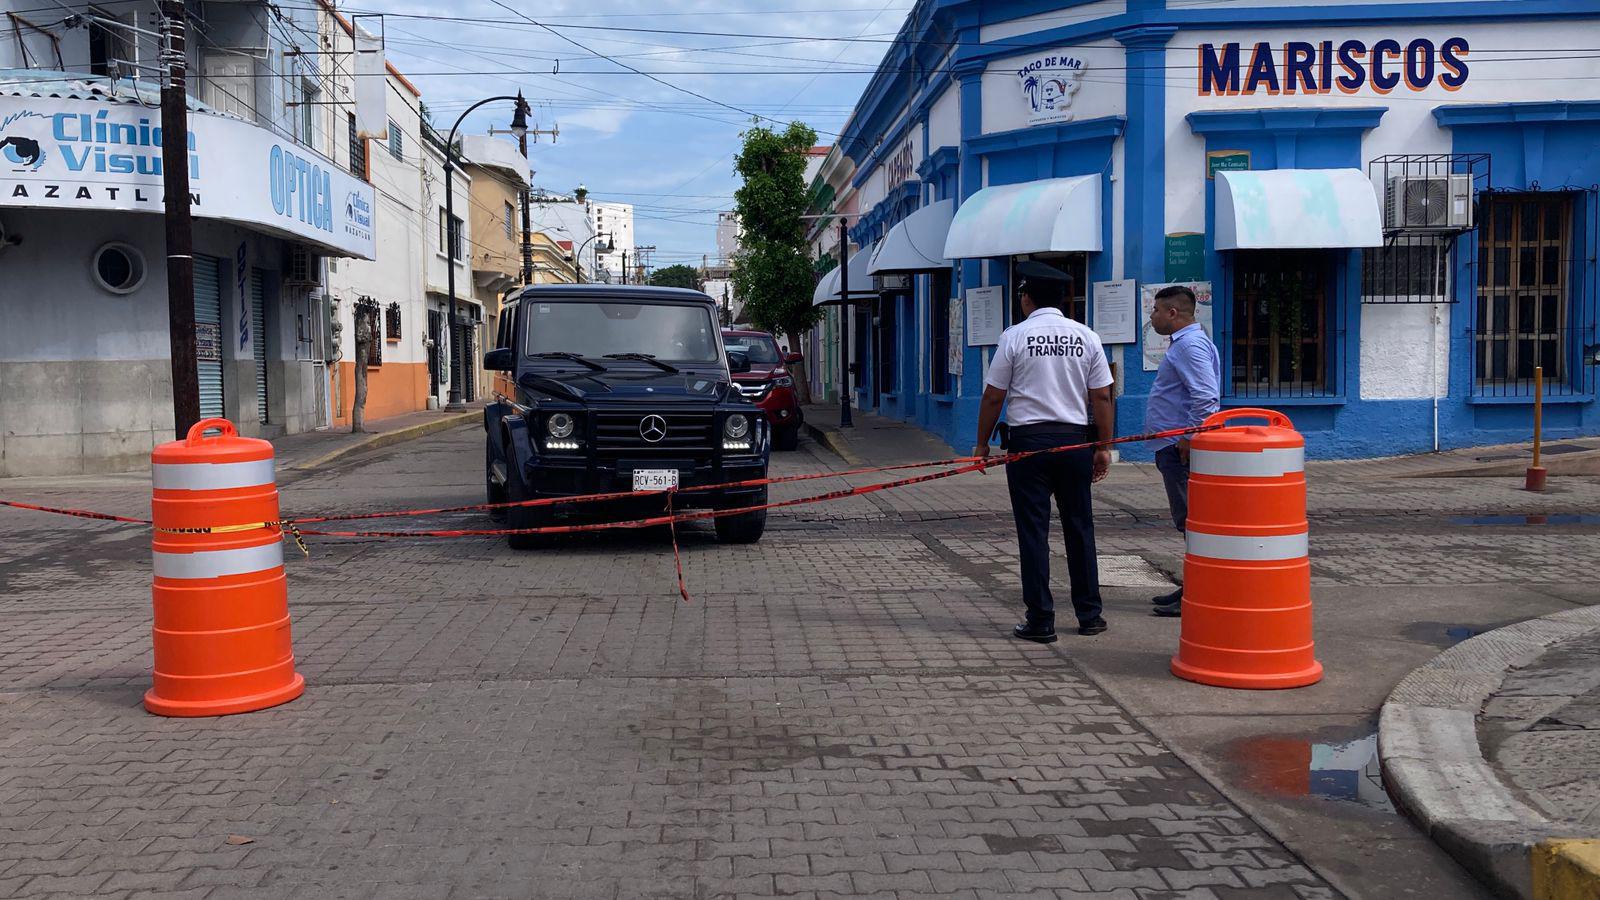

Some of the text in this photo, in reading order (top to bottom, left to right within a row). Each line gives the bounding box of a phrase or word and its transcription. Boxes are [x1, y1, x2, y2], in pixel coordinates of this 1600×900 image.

[1017, 56, 1082, 79] TACO DE MAR
[1198, 37, 1470, 97] MARISCOS
[58, 144, 199, 180] Visul
[270, 144, 333, 234] OPTICA
[1027, 345, 1084, 358] TRANSITO
[634, 475, 677, 486] RCV-561-B
